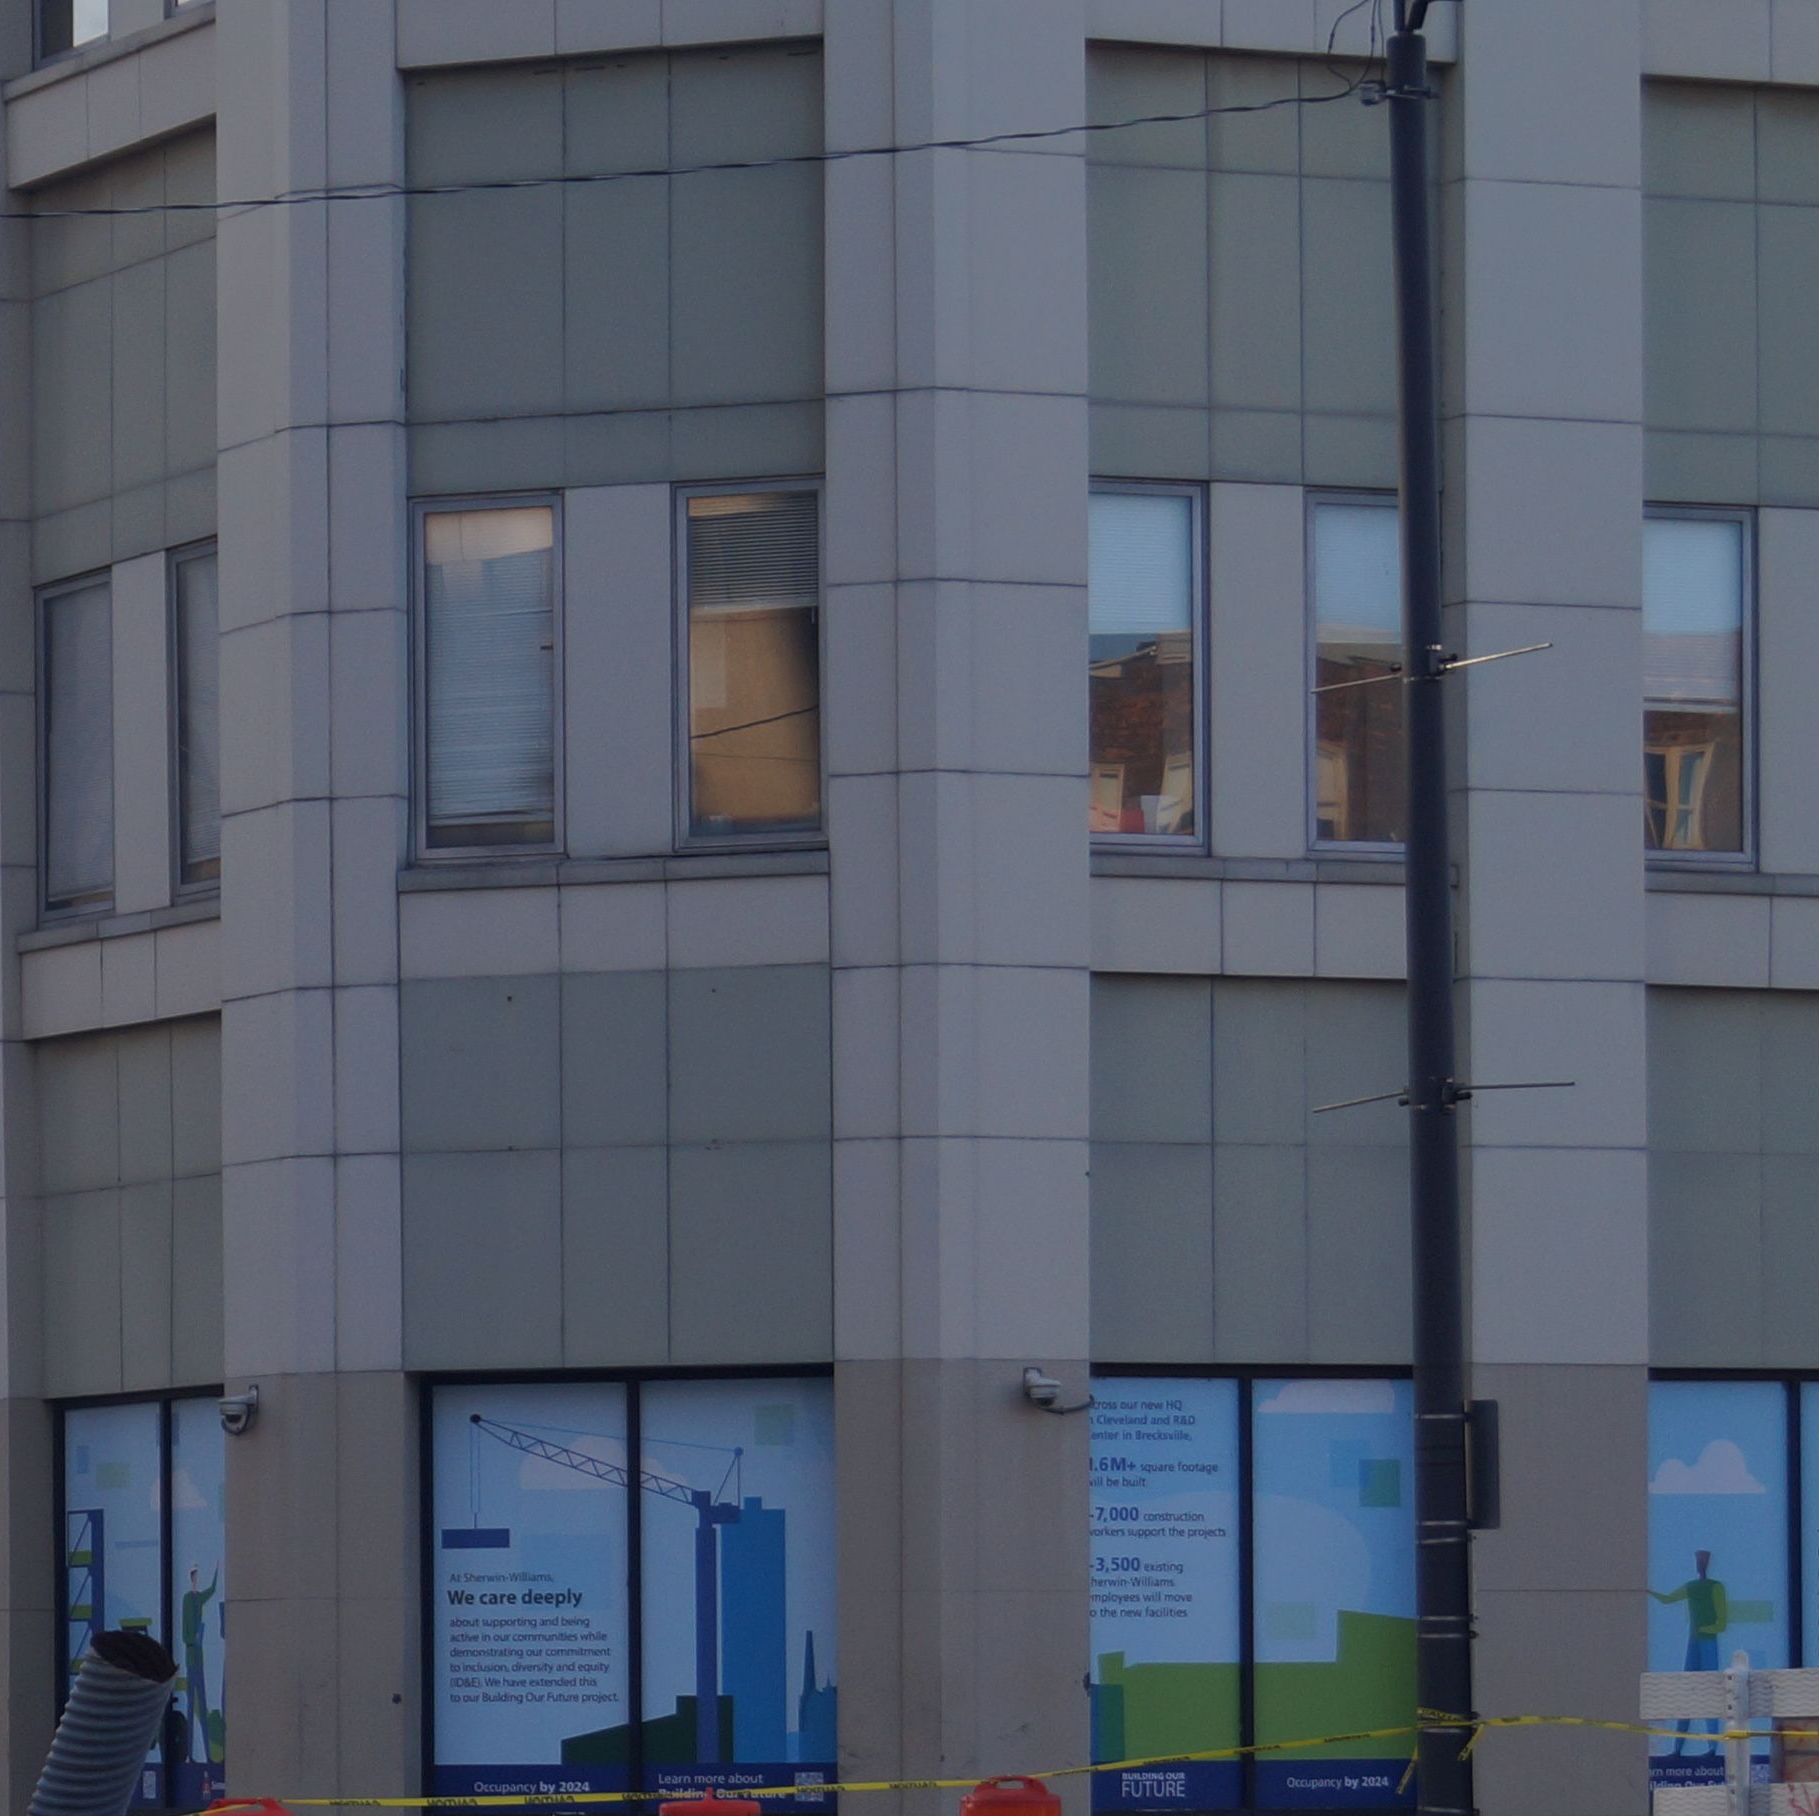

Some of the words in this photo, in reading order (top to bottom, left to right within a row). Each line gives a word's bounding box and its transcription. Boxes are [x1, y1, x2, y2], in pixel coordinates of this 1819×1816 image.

[1090, 1401, 1116, 1410] cross
[1120, 1401, 1137, 1410] our
[1141, 1401, 1163, 1410] new
[1166, 1400, 1183, 1412] HQ
[1096, 1415, 1147, 1425] Cleveland
[1150, 1415, 1170, 1425] and
[1090, 1431, 1118, 1440] enter
[1122, 1430, 1132, 1440] in
[1140, 1463, 1174, 1474] square
[1177, 1461, 1219, 1475] footage
[1106, 1477, 1119, 1487] be
[1122, 1477, 1147, 1487] built
[1143, 1511, 1204, 1521] construction
[1127, 1528, 1165, 1538] support
[1168, 1527, 1184, 1536] the
[1187, 1527, 1226, 1538] projects
[1144, 1562, 1183, 1573] existing
[1090, 1576, 1175, 1587] herwin-Williams
[447, 1590, 474, 1605] We
[479, 1592, 517, 1605] care
[521, 1588, 583, 1608] deeply
[1090, 1592, 1139, 1604] mployees
[1143, 1591, 1161, 1602] will
[1164, 1593, 1193, 1602] move
[1100, 1606, 1115, 1617] the
[1120, 1609, 1142, 1617] new
[1145, 1606, 1188, 1617] facilities
[450, 1618, 479, 1627] about
[482, 1618, 537, 1629] supporting
[539, 1617, 559, 1626] and
[563, 1617, 590, 1628] being
[450, 1633, 479, 1641] active
[482, 1633, 491, 1641] in
[513, 1633, 577, 1641] communities
[580, 1632, 608, 1641] while
[450, 1648, 524, 1659] demonstrating
[526, 1649, 542, 1657] our
[545, 1648, 611, 1657] commitment
[450, 1663, 461, 1672] to
[512, 1662, 554, 1673] diversity
[556, 1662, 575, 1671] and
[578, 1662, 610, 1673] equity
[450, 1693, 461, 1702] to
[463, 1694, 480, 1702] our
[483, 1692, 524, 1704] Building
[525, 1692, 545, 1702] Our
[547, 1692, 579, 1702] Future
[659, 1773, 690, 1785] Learn
[694, 1776, 724, 1785] more
[728, 1773, 763, 1785] about
[1287, 1777, 1342, 1790] Occupancy
[1345, 1776, 1360, 1790] by
[1362, 1776, 1389, 1787] 2024
[473, 1781, 537, 1794] Occupancy
[539, 1781, 556, 1794] by
[558, 1781, 590, 1791] 2024
[1122, 1781, 1186, 1797] FUTURE
